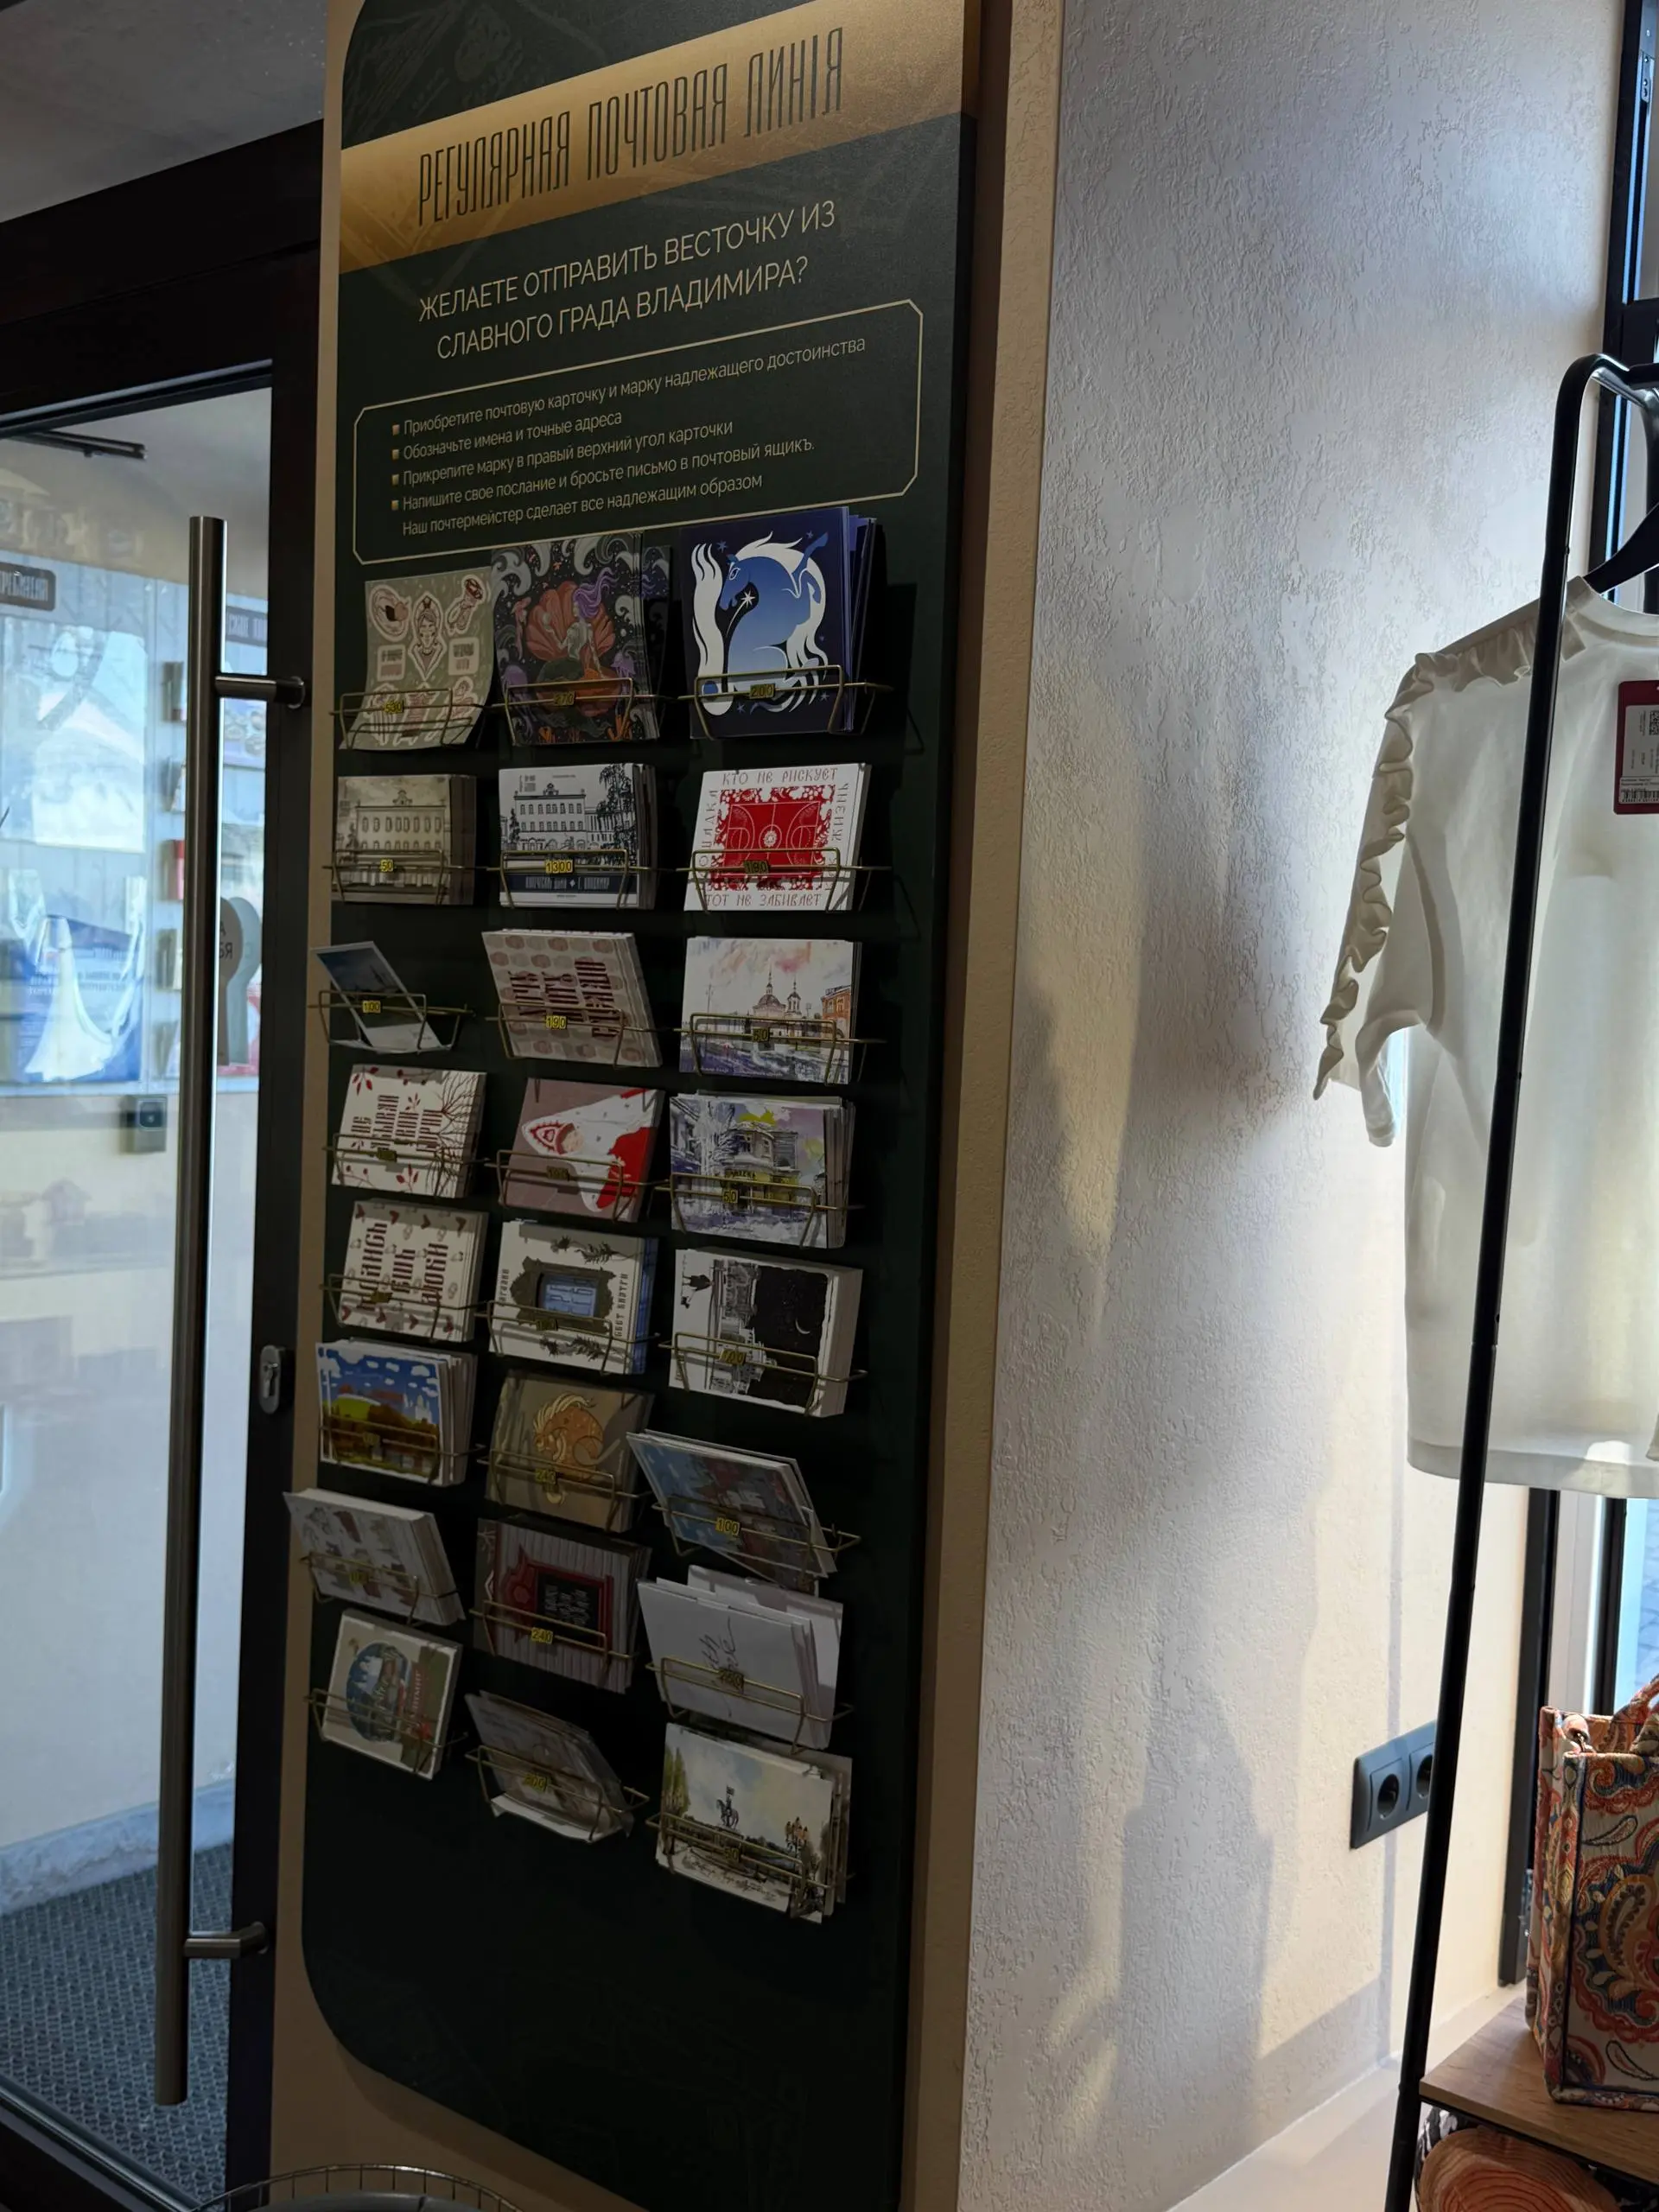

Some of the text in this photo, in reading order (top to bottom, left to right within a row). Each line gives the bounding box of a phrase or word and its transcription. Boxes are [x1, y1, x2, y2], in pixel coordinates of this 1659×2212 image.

[419, 111, 570, 225] РЕГУЛЯРНАЯ
[588, 64, 728, 179] ПОЧТОВАЯ
[419, 200, 835, 321] ЖЕЛАЕТЕ ОТПРАВИТЬ ВЕСТОЧКУ ИЗ
[437, 256, 808, 359] СЛАВНОГО ГРАДА ВЛАДИМИРА?
[404, 338, 866, 436] Приобретите почтовую карточку и марку надлежащего достоинства
[403, 411, 622, 460] Обозначьте имена и точные адреса
[404, 421, 733, 487] Прикрепите марку в правый верхний угол карточки
[403, 491, 463, 511] Напишите
[464, 486, 494, 502] свое
[496, 477, 556, 497] послание
[558, 475, 568, 488] и
[569, 467, 625, 489] бросьте
[626, 459, 677, 478] письмо
[680, 457, 689, 471] в
[691, 443, 760, 468] почтовый
[403, 474, 762, 537] Наш почтермейстер сделает все надлежащим образом
[722, 767, 838, 785] КТО НЕ РИСКУЕТ
[547, 861, 571, 873] 1300
[705, 894, 729, 906] ТОТ
[737, 894, 752, 906] НЕ
[547, 1016, 566, 1028] 190
[723, 1190, 737, 1203] 50
[718, 1517, 739, 1534] 100
